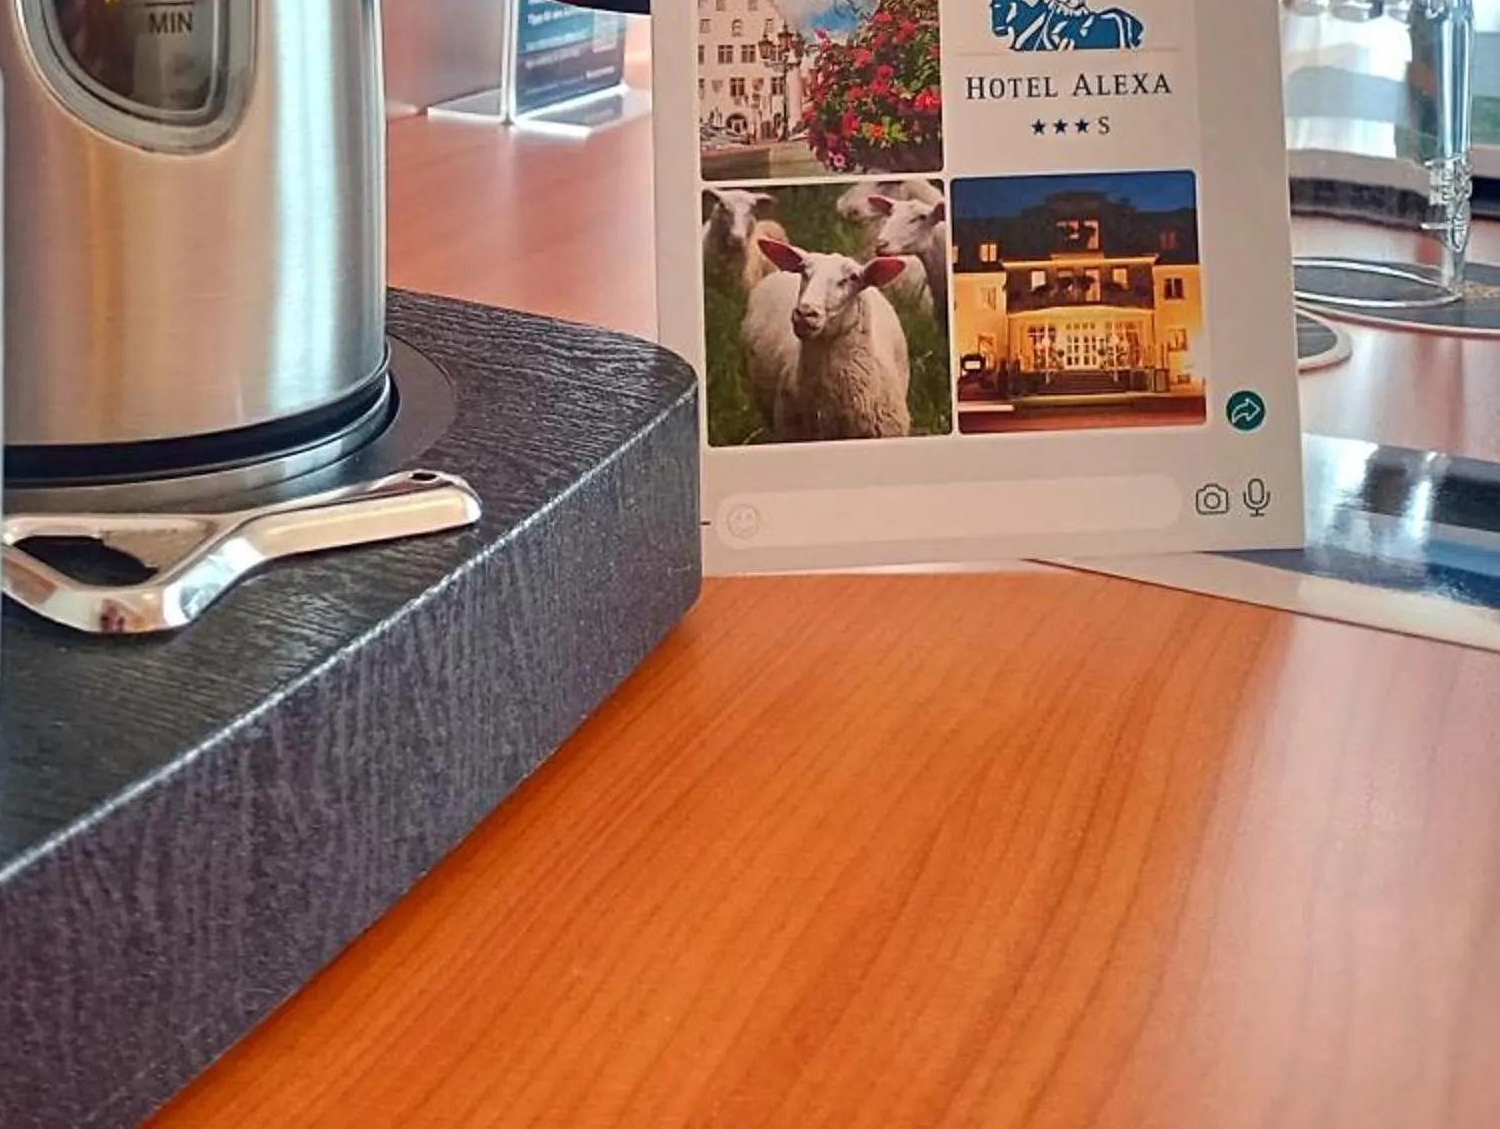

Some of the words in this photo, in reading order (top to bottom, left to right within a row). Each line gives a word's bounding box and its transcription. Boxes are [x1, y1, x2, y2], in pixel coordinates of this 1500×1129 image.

[148, 13, 193, 35] MIN
[965, 76, 1059, 100] HOTEL
[1072, 73, 1173, 97] ALEXA
[1097, 116, 1111, 135] S
